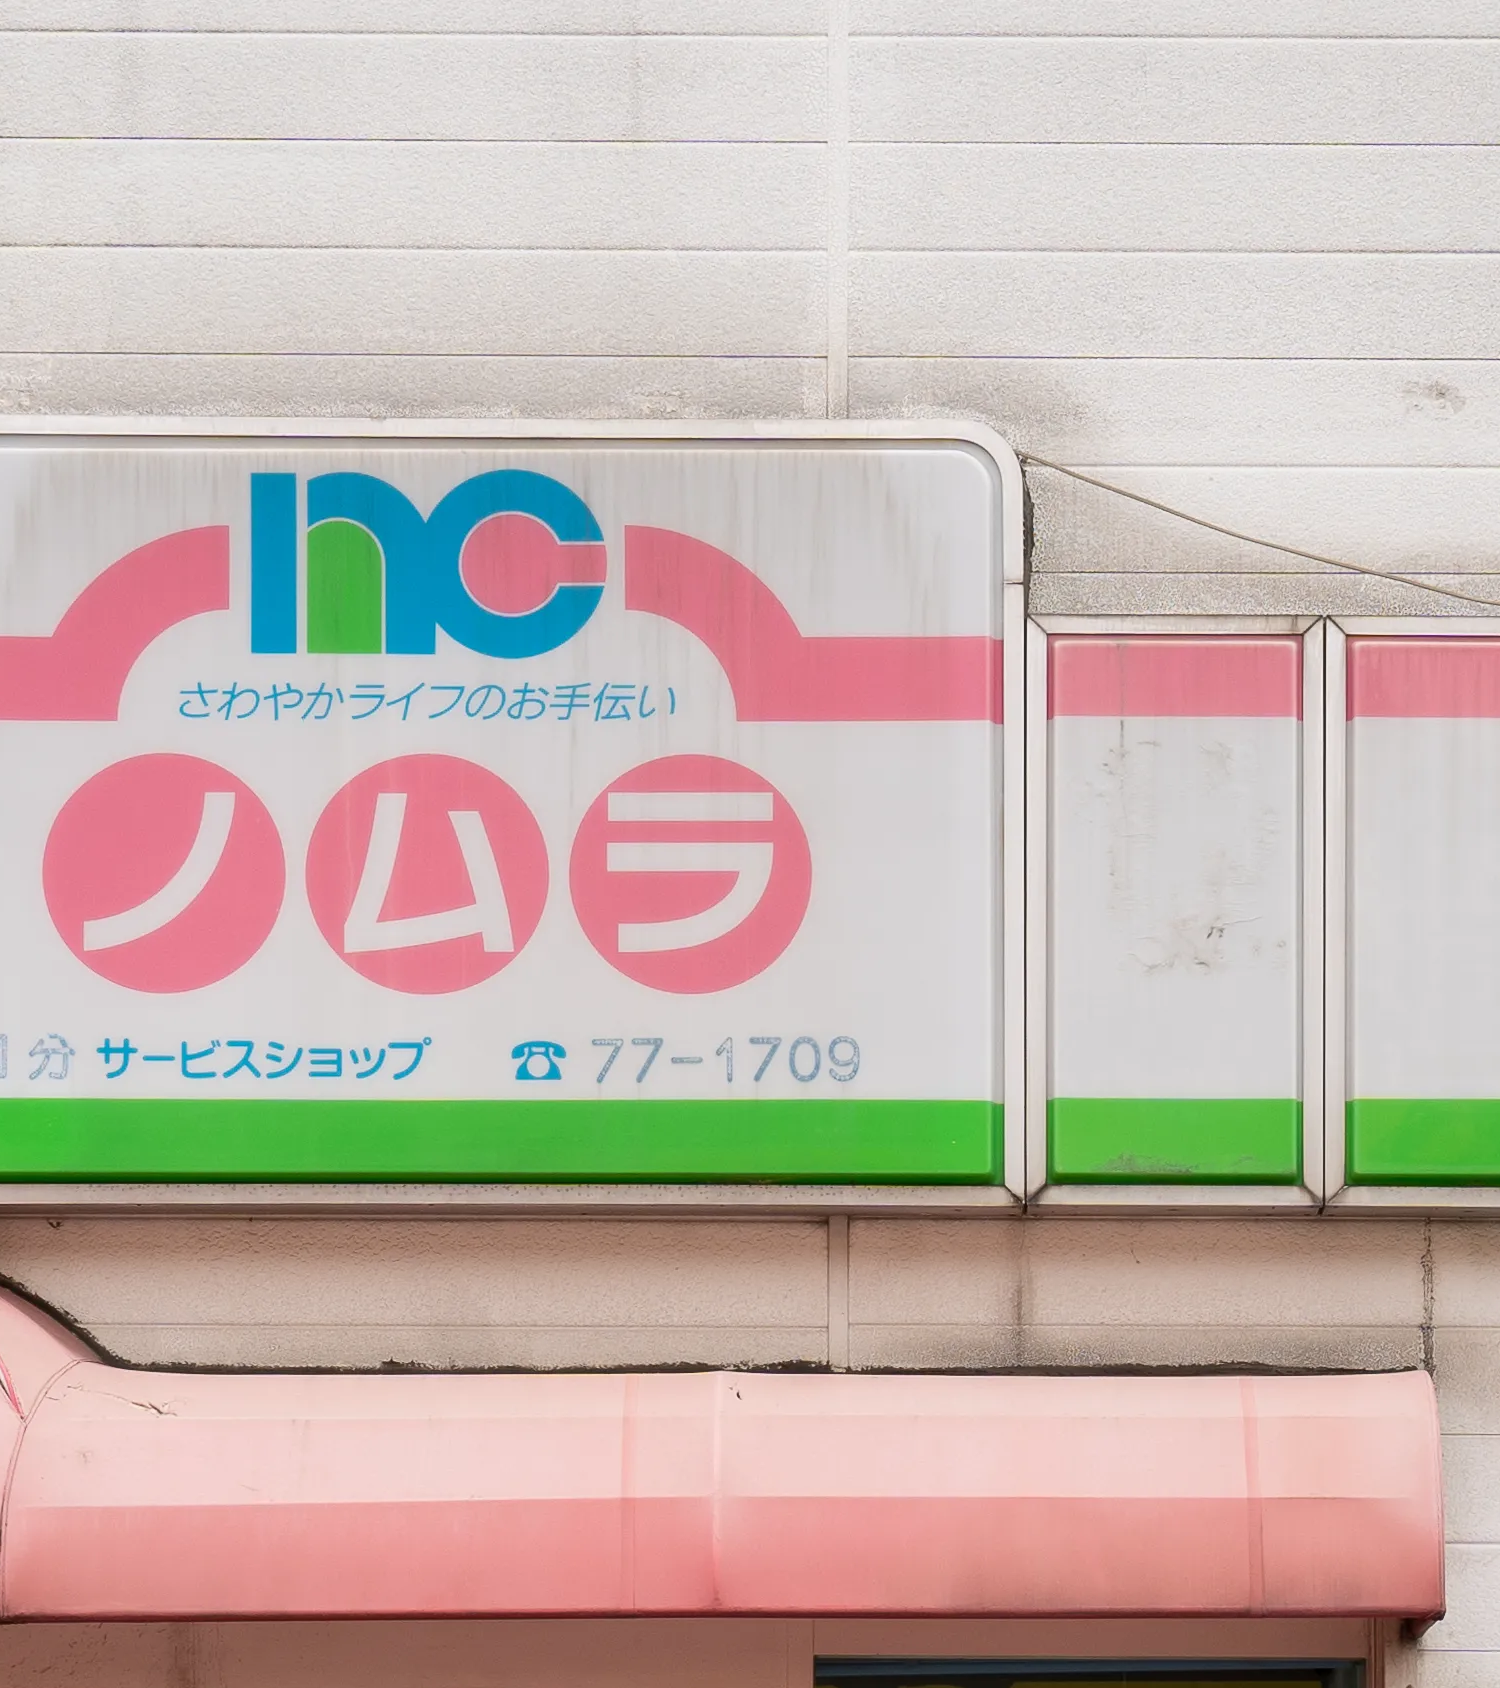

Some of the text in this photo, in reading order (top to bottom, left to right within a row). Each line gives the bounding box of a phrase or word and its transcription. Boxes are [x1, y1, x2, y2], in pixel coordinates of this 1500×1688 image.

[177, 680, 677, 724] さわやかライフのお手伝い
[82, 790, 775, 956] ノムラ
[95, 1034, 433, 1081] サービスショップ
[591, 1034, 863, 1083] 77-1709
